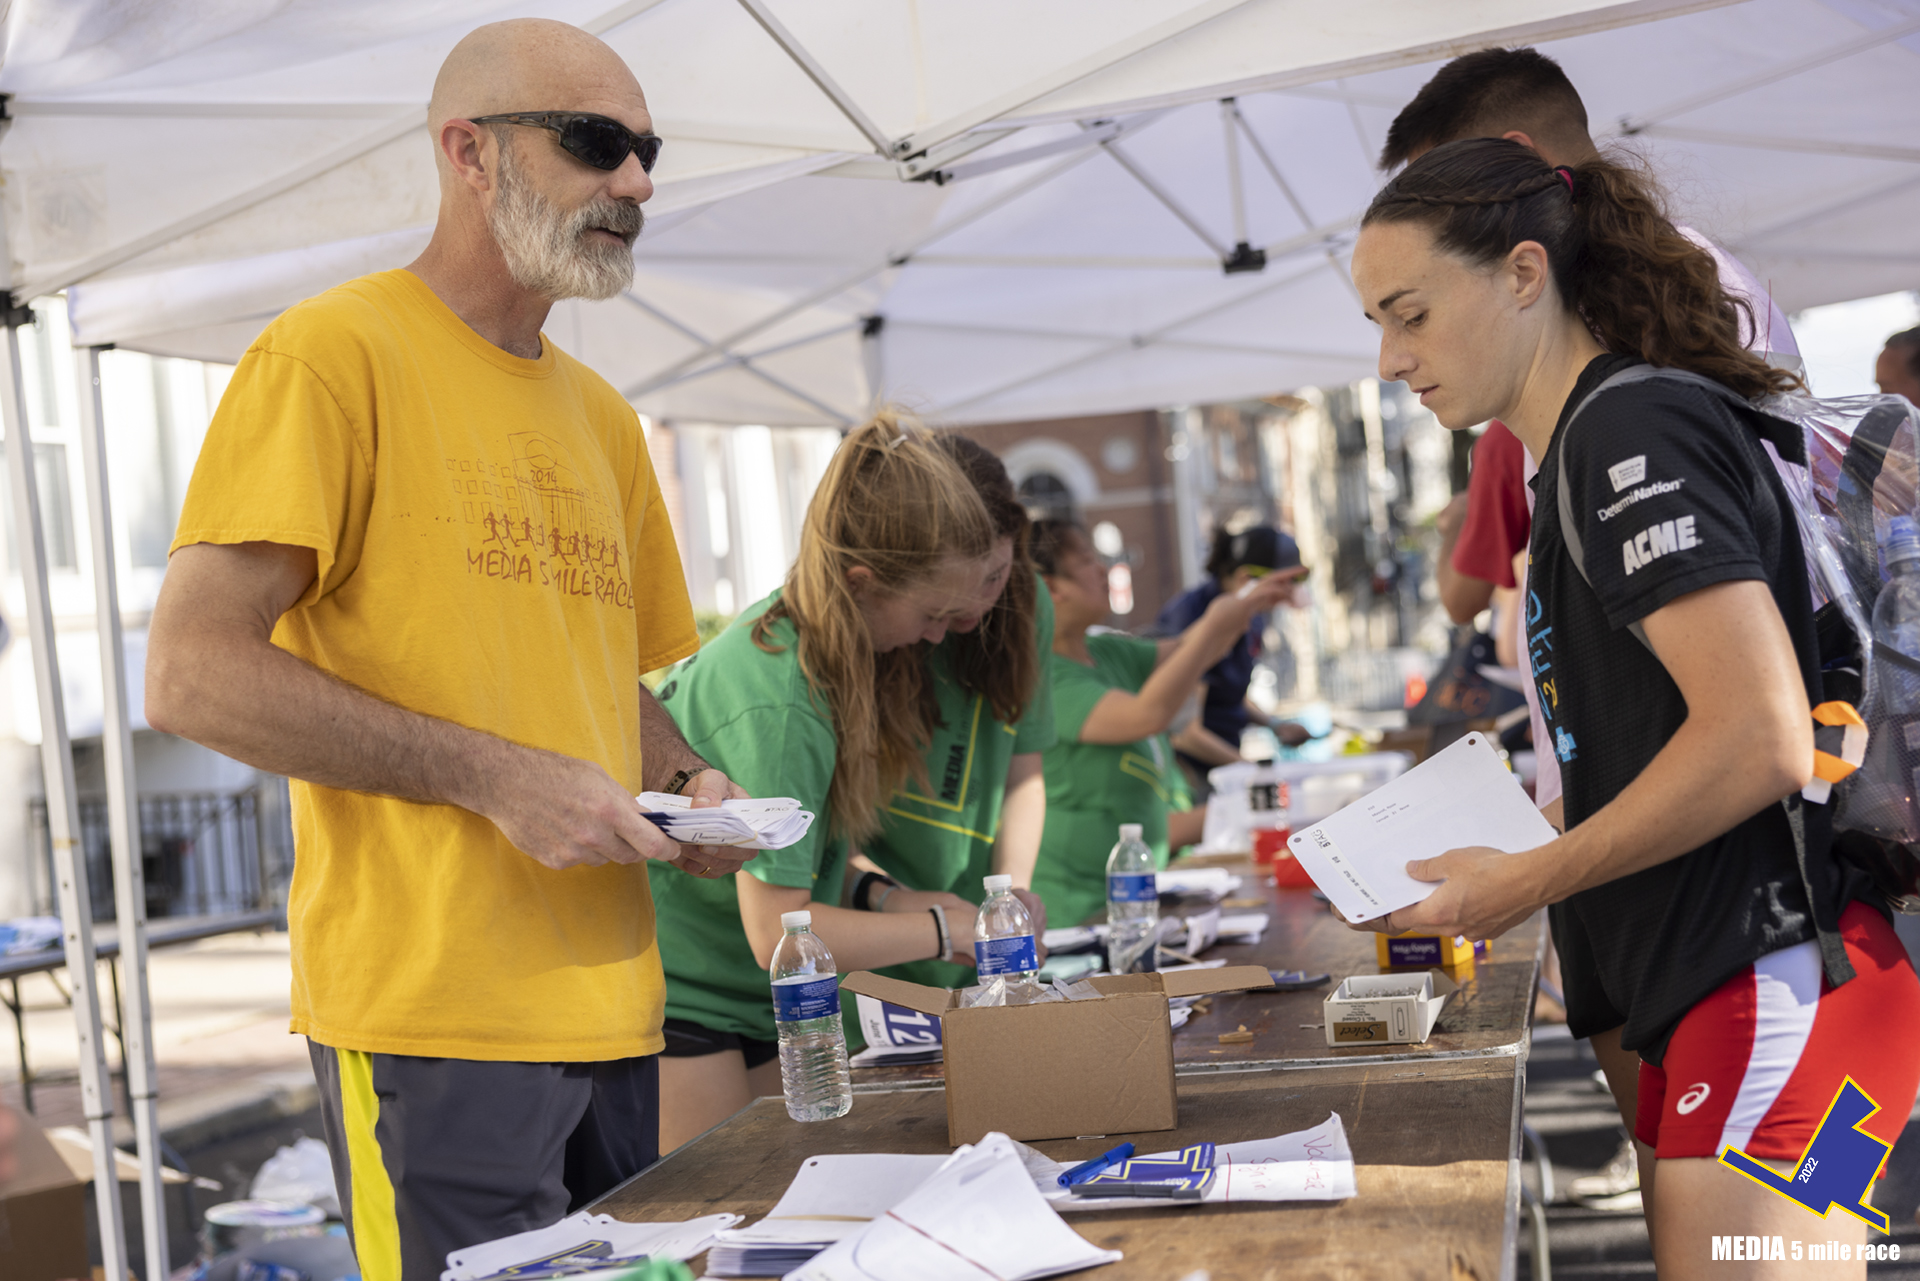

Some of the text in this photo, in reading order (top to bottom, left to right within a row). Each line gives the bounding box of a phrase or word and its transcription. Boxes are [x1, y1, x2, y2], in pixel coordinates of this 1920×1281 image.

[530, 469, 557, 483] 2014
[1623, 515, 1697, 576] ACME
[467, 548, 532, 583] MEDIA
[940, 744, 965, 801] MEDIA
[1340, 1023, 1381, 1040] Select
